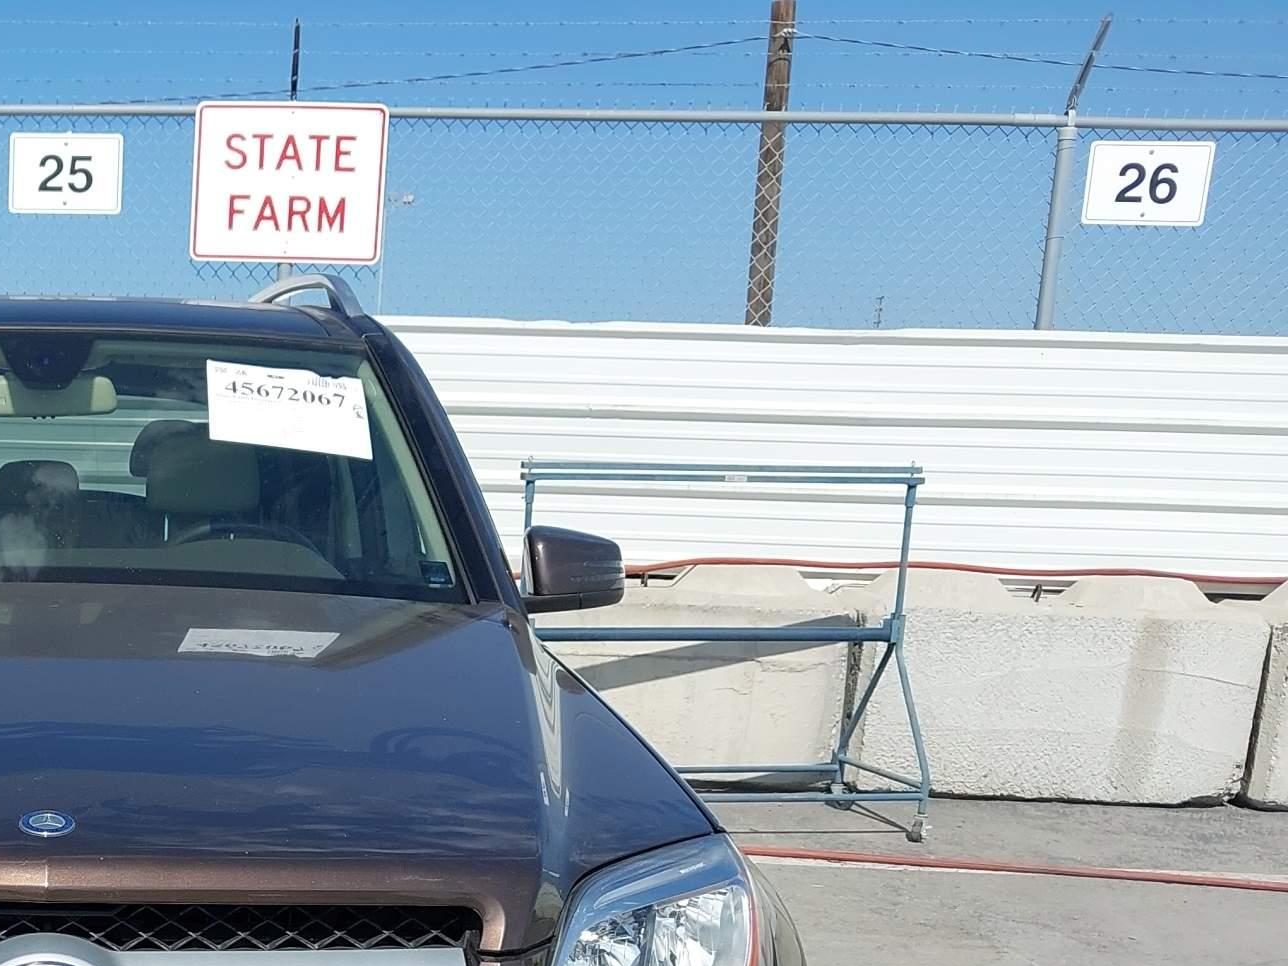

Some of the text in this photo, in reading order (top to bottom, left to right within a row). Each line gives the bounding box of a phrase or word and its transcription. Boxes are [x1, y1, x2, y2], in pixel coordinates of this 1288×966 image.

[224, 133, 358, 173] STATE
[38, 154, 94, 193] 25
[1114, 162, 1179, 205] 26
[227, 194, 347, 233] FARM
[224, 380, 346, 409] 45672067
